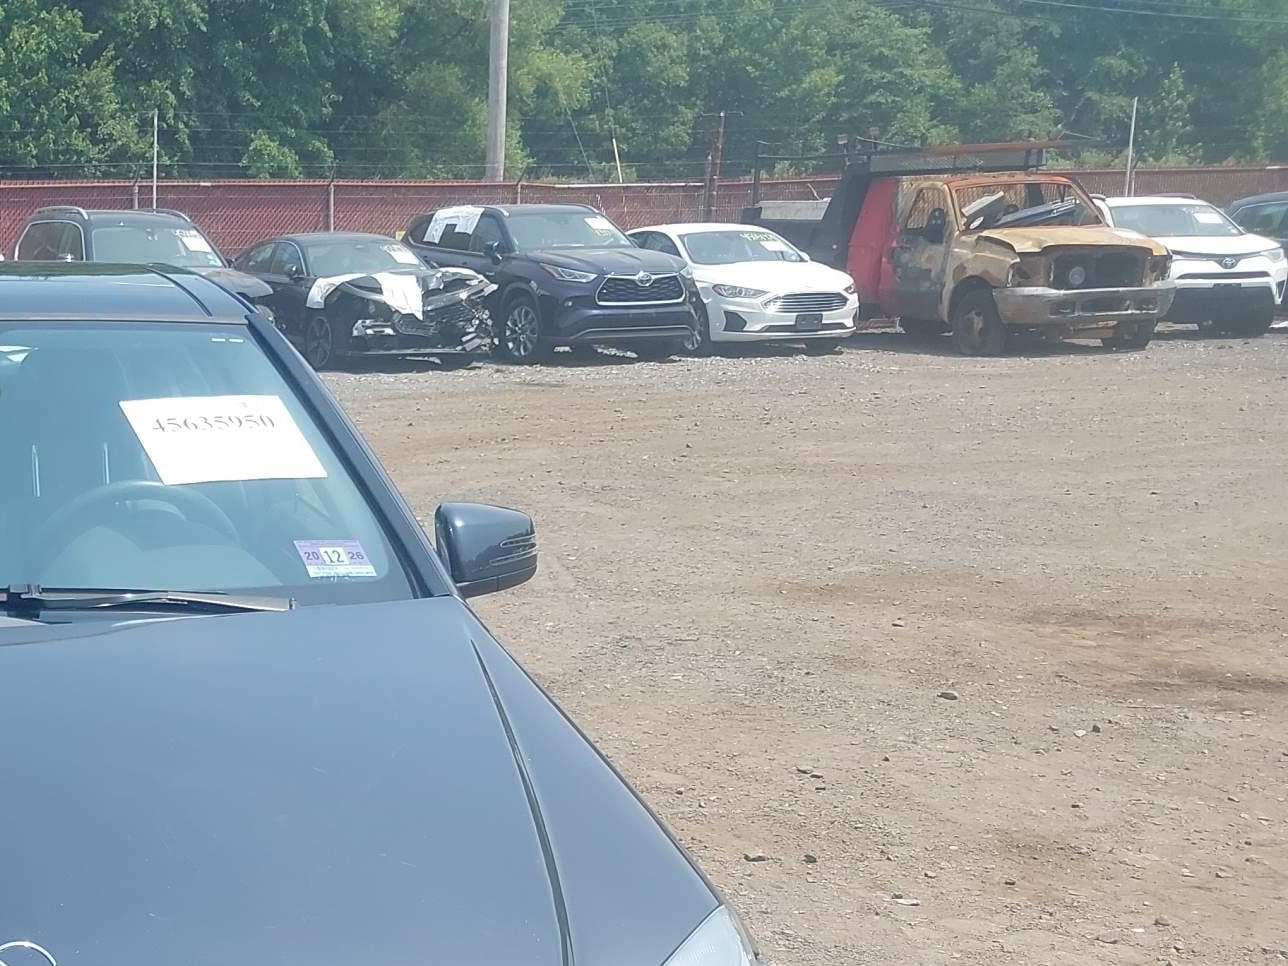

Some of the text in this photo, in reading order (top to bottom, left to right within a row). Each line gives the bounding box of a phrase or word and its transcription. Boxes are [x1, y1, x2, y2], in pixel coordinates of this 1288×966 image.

[152, 414, 275, 433] 45635950
[304, 549, 365, 564] 20 12 26
